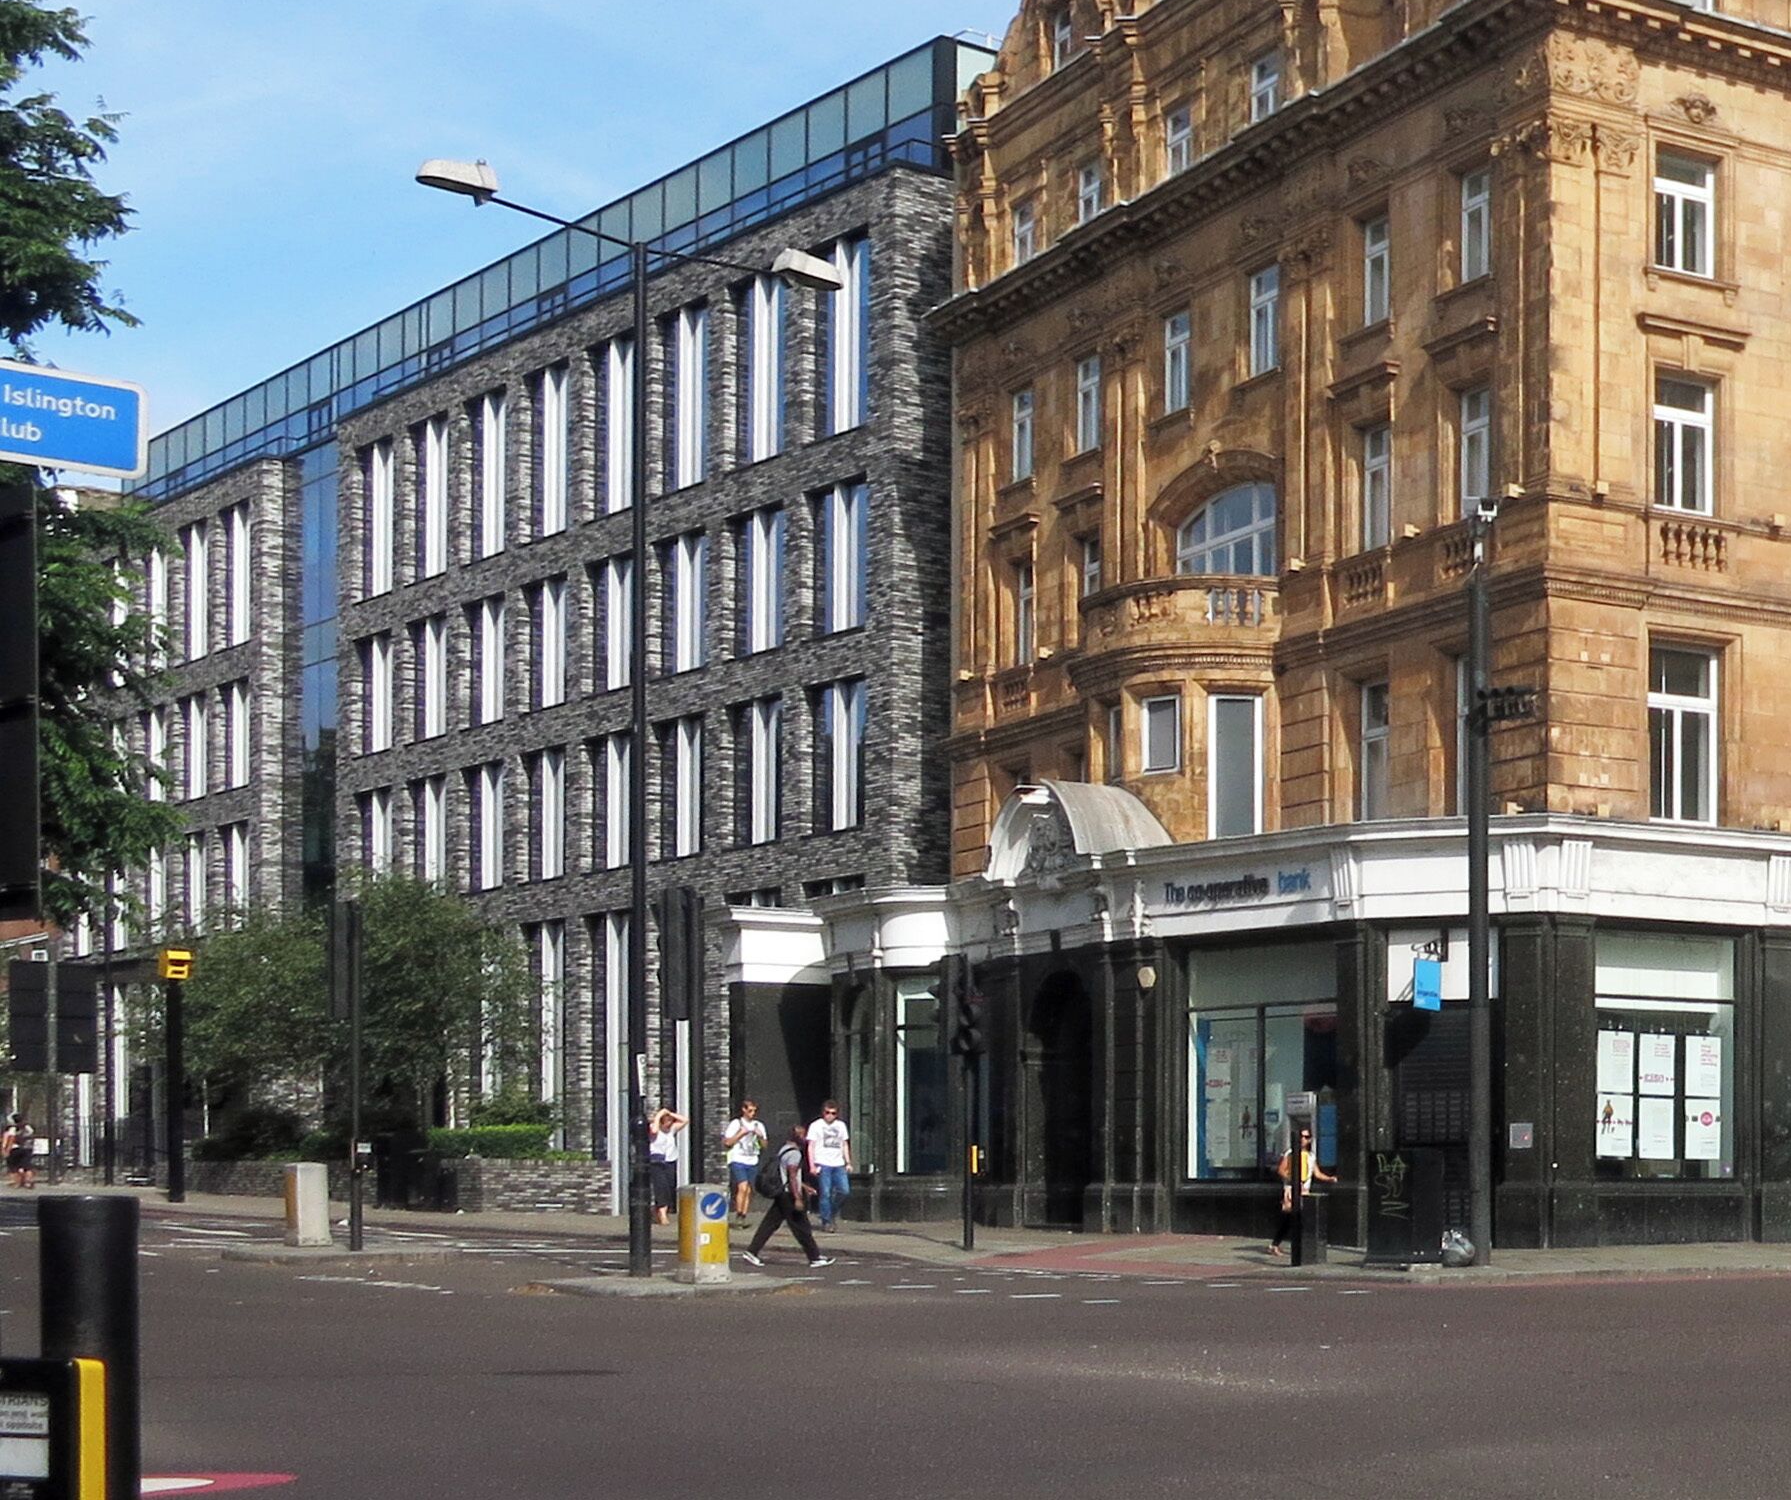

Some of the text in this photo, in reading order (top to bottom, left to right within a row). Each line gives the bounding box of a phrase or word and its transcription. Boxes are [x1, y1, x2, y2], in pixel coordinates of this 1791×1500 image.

[4, 384, 116, 420] Islington
[1, 417, 42, 441] lub
[1278, 867, 1311, 895] bank
